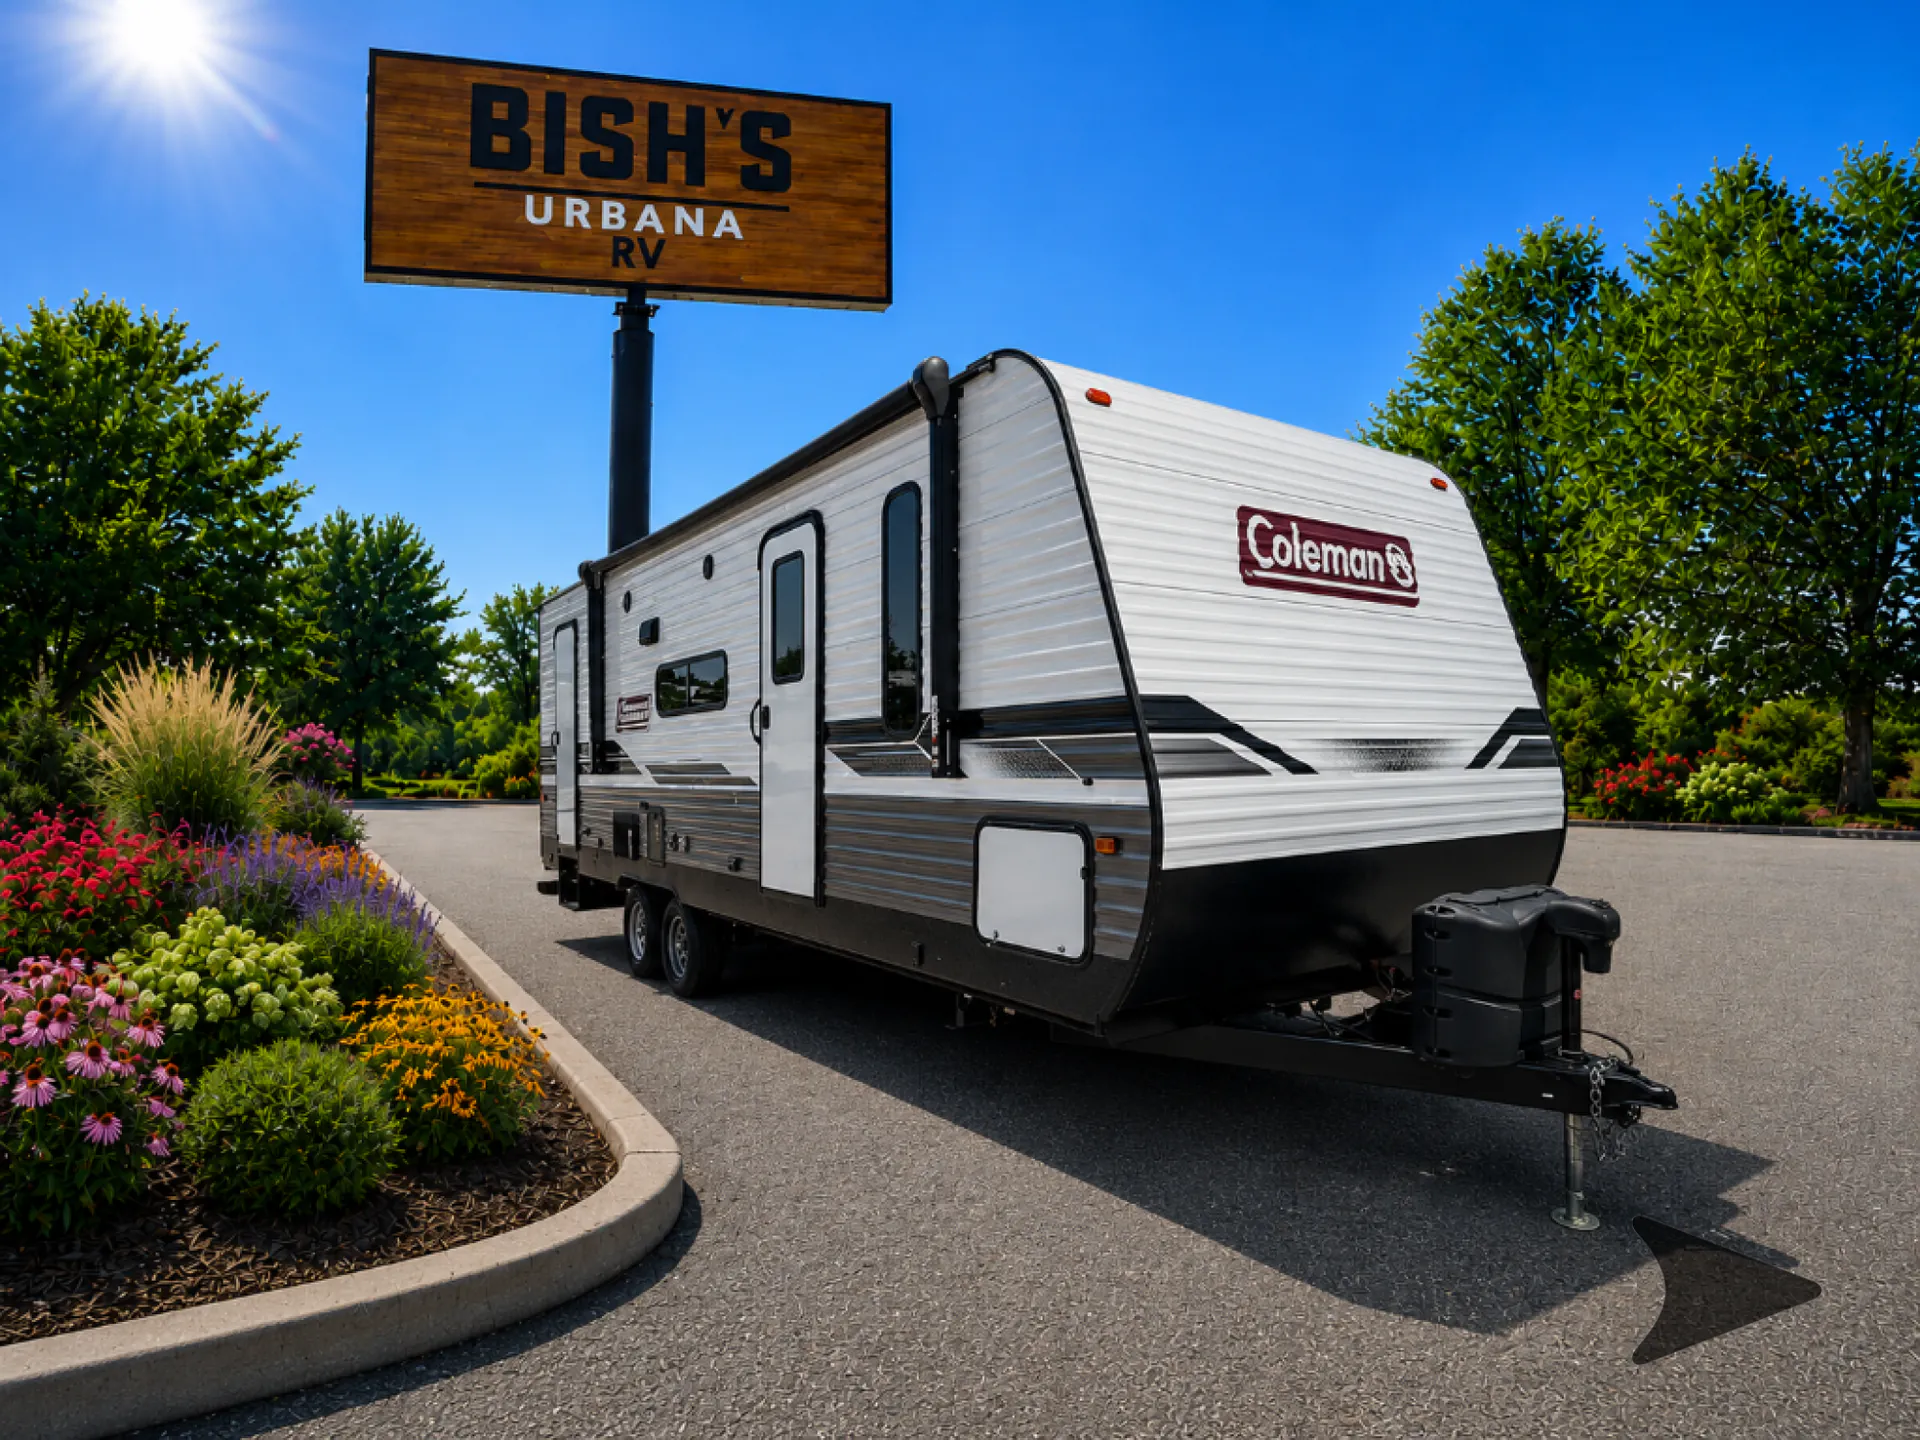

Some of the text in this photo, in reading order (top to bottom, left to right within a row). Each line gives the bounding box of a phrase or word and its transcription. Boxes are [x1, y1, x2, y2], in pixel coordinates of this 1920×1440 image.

[470, 83, 792, 193] BISH'S
[525, 194, 744, 240] URBANA
[611, 236, 666, 269] RV
[1247, 514, 1385, 582] Coleman
